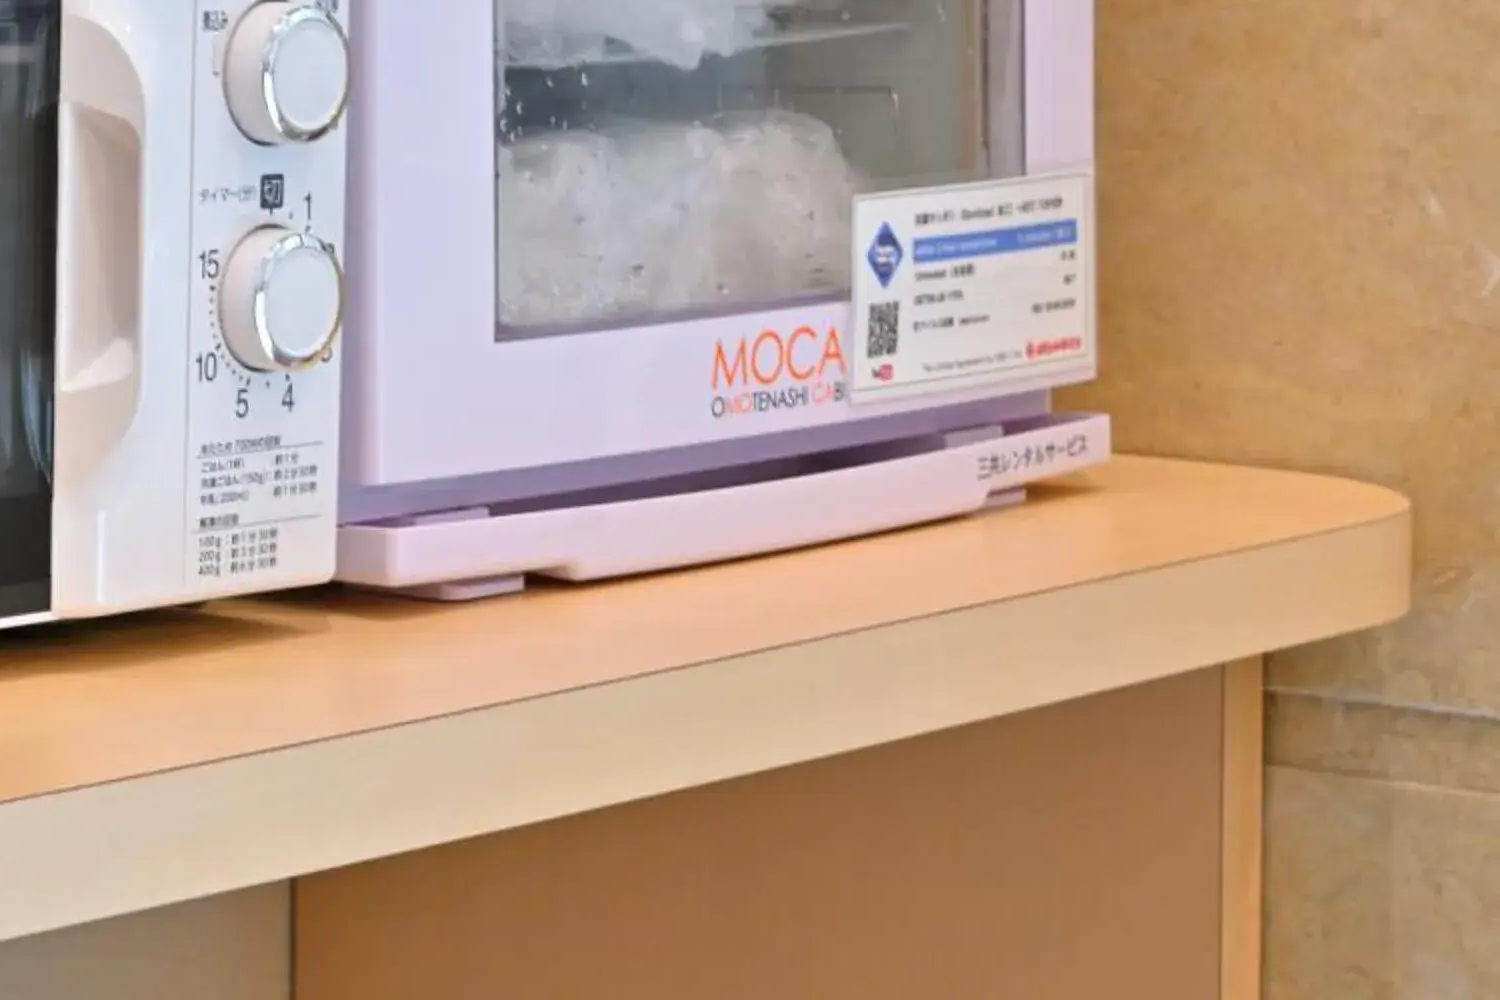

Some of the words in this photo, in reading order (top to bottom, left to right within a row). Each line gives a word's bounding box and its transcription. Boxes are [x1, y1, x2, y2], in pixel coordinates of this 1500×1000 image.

[303, 190, 312, 221] 1
[199, 250, 219, 278] 15
[196, 352, 217, 383] 10
[712, 325, 847, 391] MOCA
[235, 389, 249, 419] 5
[281, 382, 295, 413] 4
[711, 385, 809, 418] OMOTENASHI
